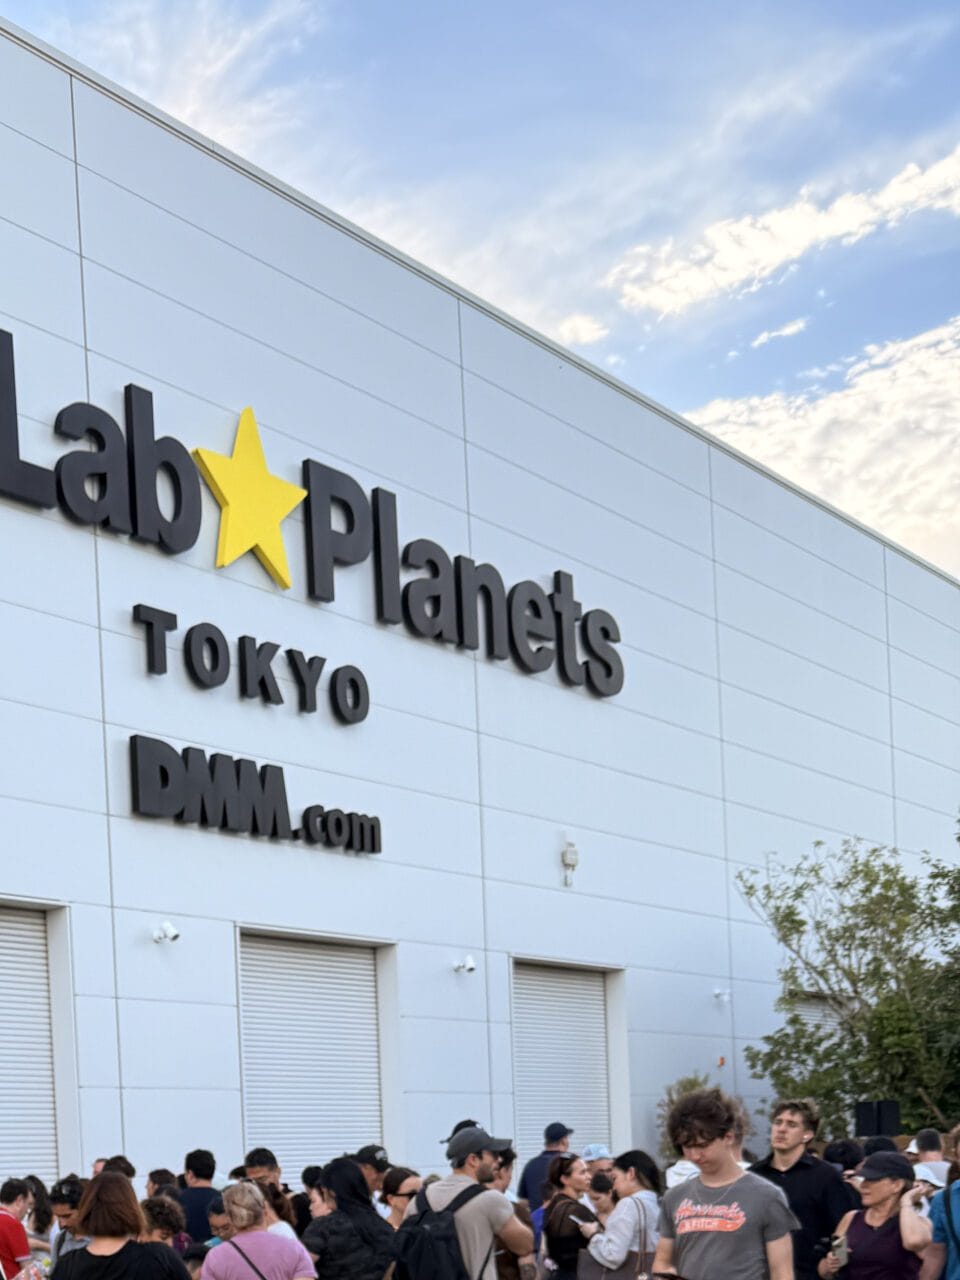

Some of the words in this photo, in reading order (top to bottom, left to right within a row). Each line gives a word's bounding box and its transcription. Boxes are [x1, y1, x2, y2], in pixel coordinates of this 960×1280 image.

[302, 459, 625, 698] Planets
[133, 604, 370, 725] TOKYO
[130, 735, 382, 854] DMM.com
